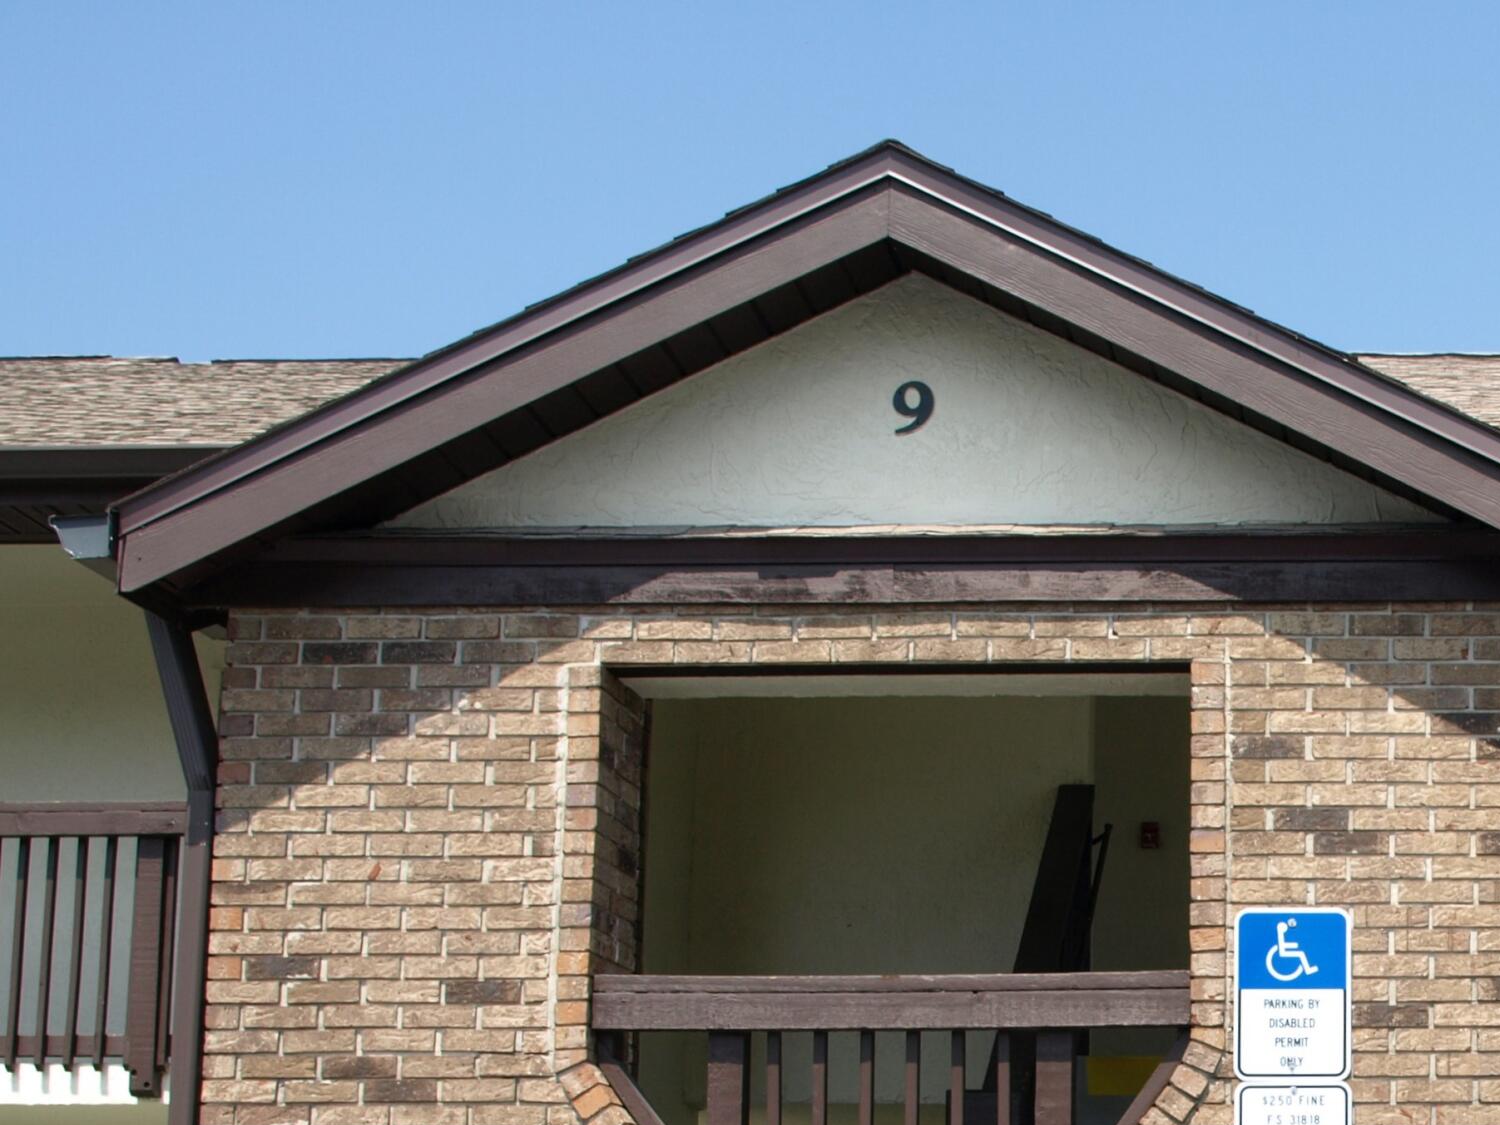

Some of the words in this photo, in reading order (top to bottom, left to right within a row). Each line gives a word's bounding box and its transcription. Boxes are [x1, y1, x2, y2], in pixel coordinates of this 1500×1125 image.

[892, 380, 935, 437] 9
[1263, 998, 1303, 1009] PARKING
[1308, 998, 1320, 1008] BY
[1268, 1017, 1316, 1028] DISABLED
[1274, 1036, 1308, 1047] PERMIT
[1279, 1055, 1304, 1067] ONLY
[1262, 1094, 1292, 1106] $250
[1298, 1094, 1325, 1105] FINE
